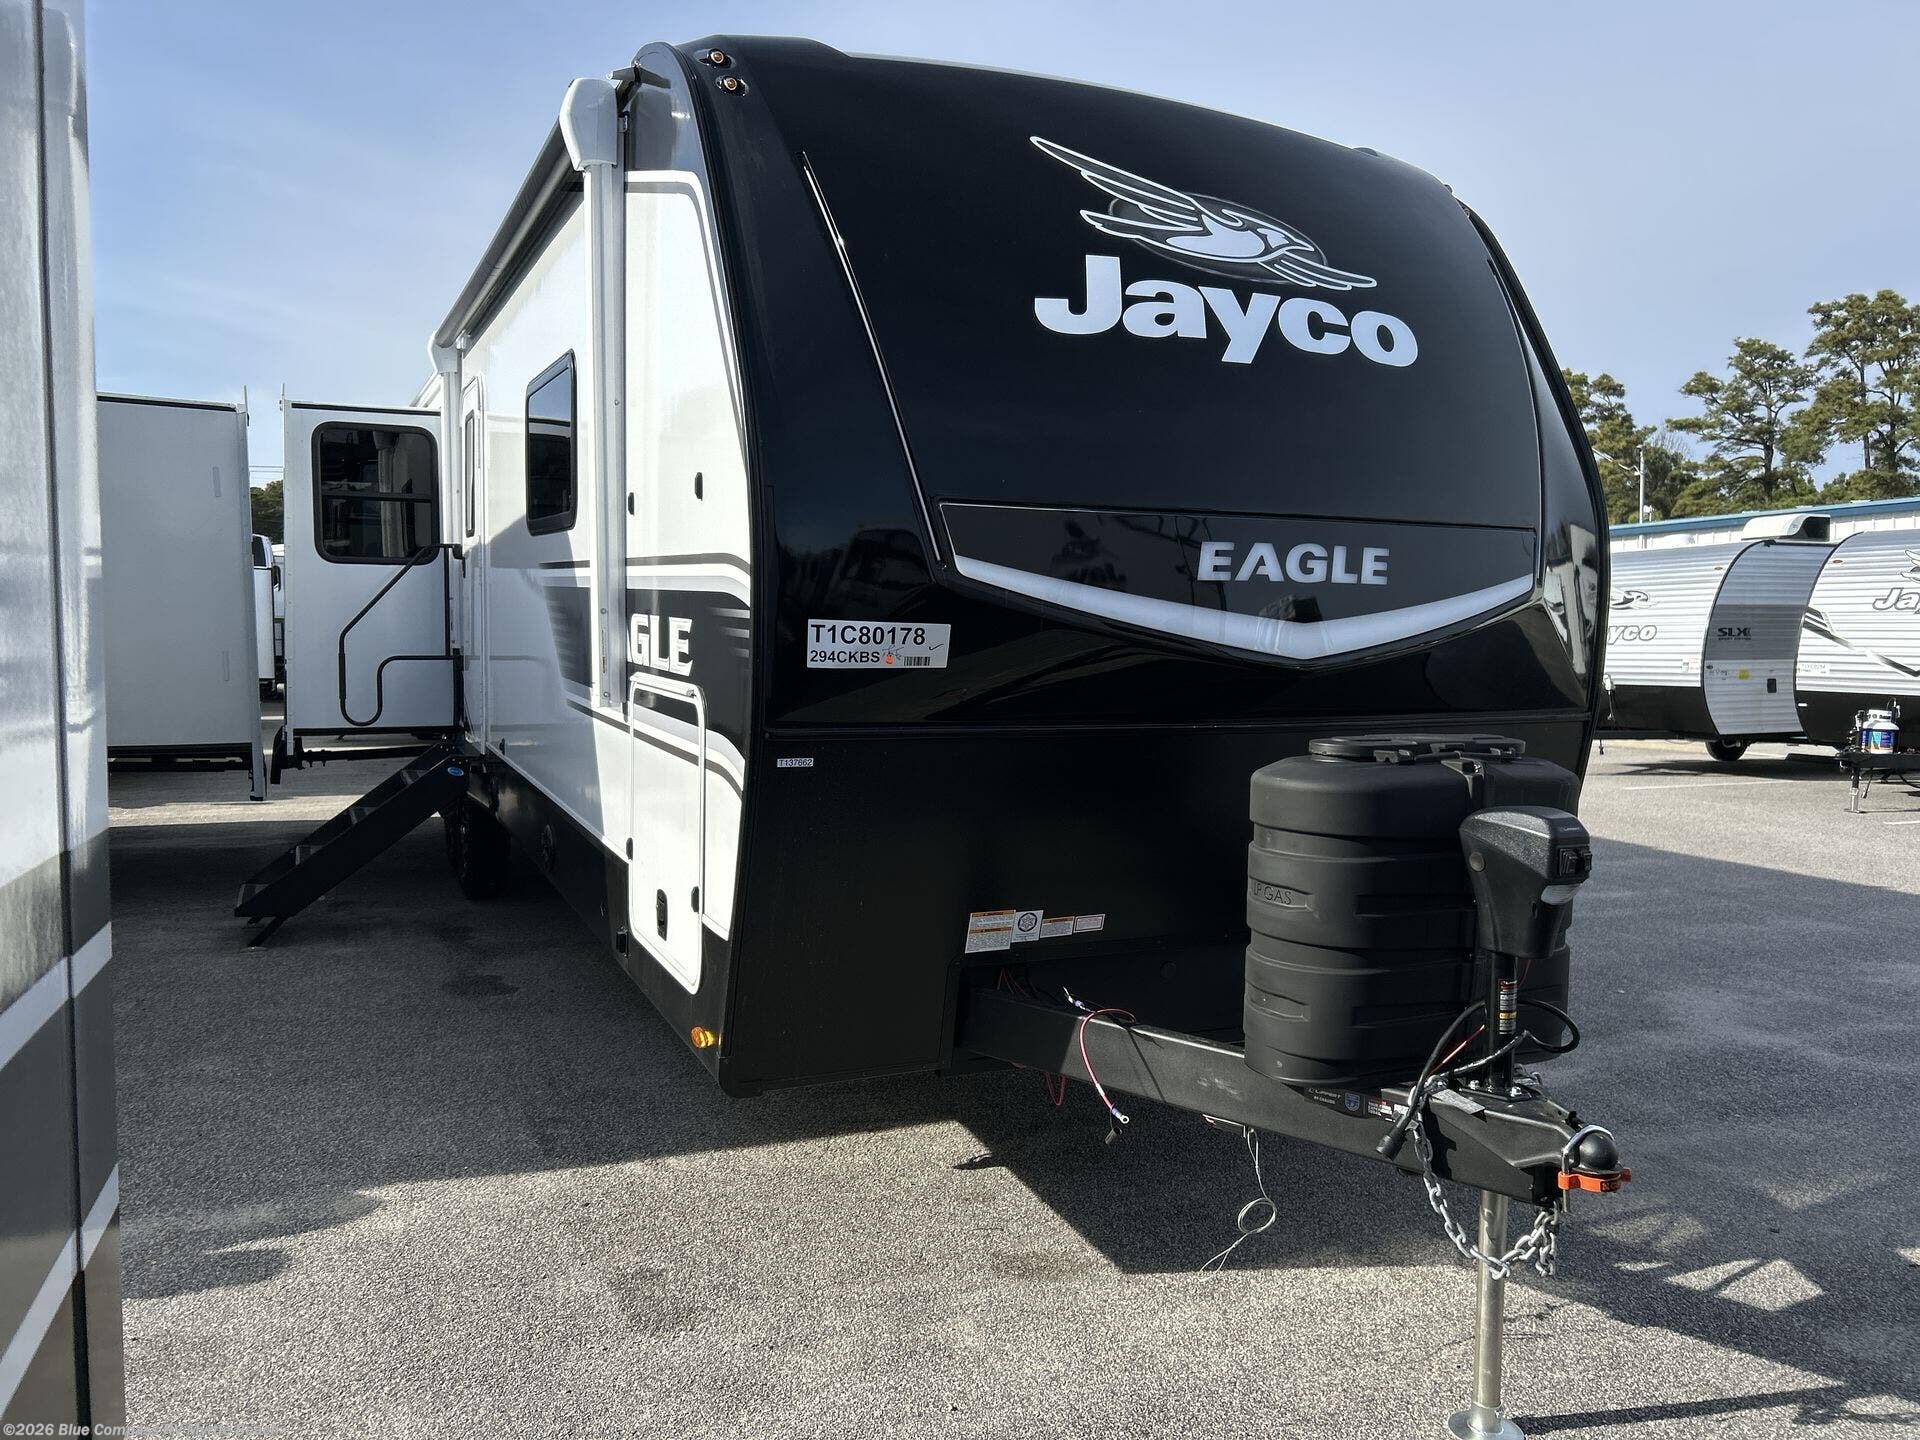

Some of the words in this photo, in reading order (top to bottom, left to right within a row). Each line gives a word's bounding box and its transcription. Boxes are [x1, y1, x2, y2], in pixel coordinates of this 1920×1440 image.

[1034, 254, 1419, 368] Jayco
[1197, 541, 1391, 585] EAGLE
[810, 624, 926, 646] T1C80178
[809, 649, 880, 663] 294CKBS
[1264, 885, 1292, 905] GAS
